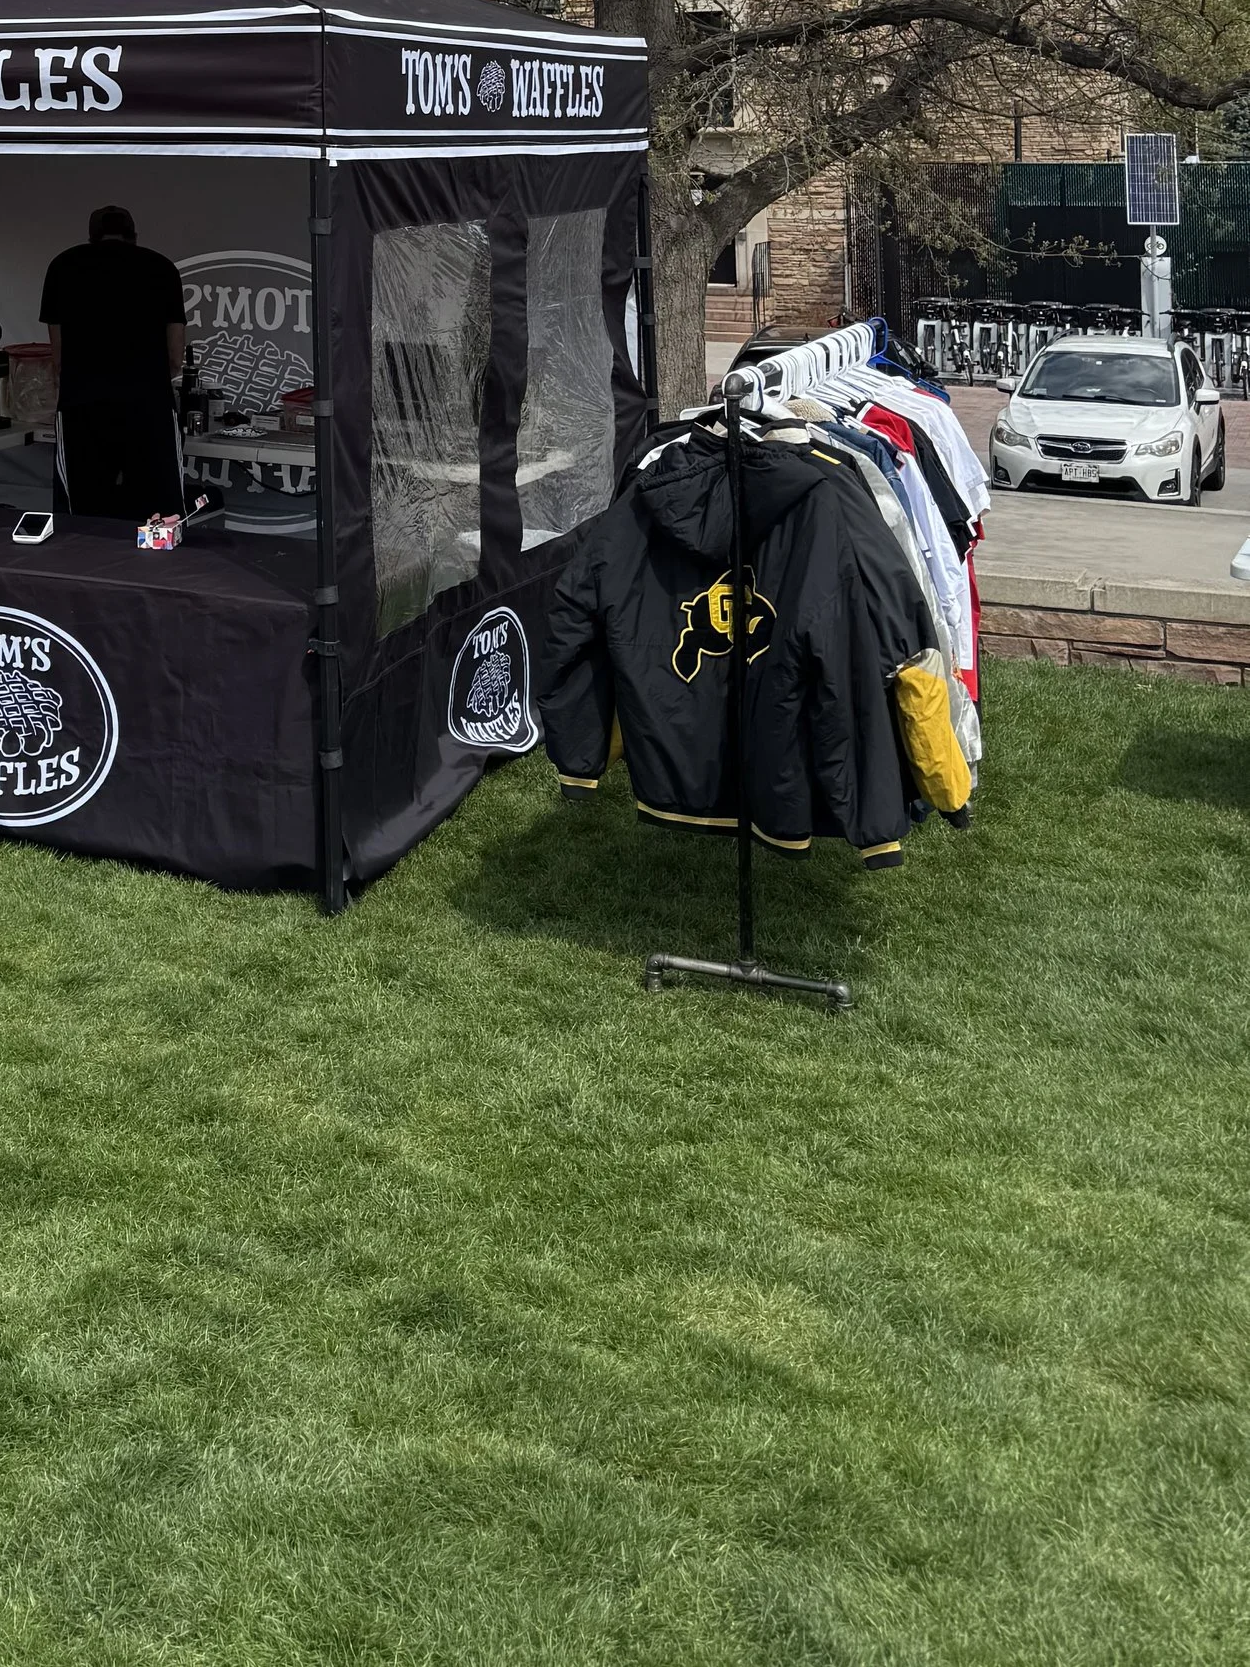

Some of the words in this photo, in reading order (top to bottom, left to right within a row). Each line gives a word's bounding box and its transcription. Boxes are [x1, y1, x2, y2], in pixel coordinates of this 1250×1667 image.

[401, 47, 472, 117] TOM'S
[510, 58, 604, 118] WAFFLES
[460, 688, 522, 742] WAFFLES
